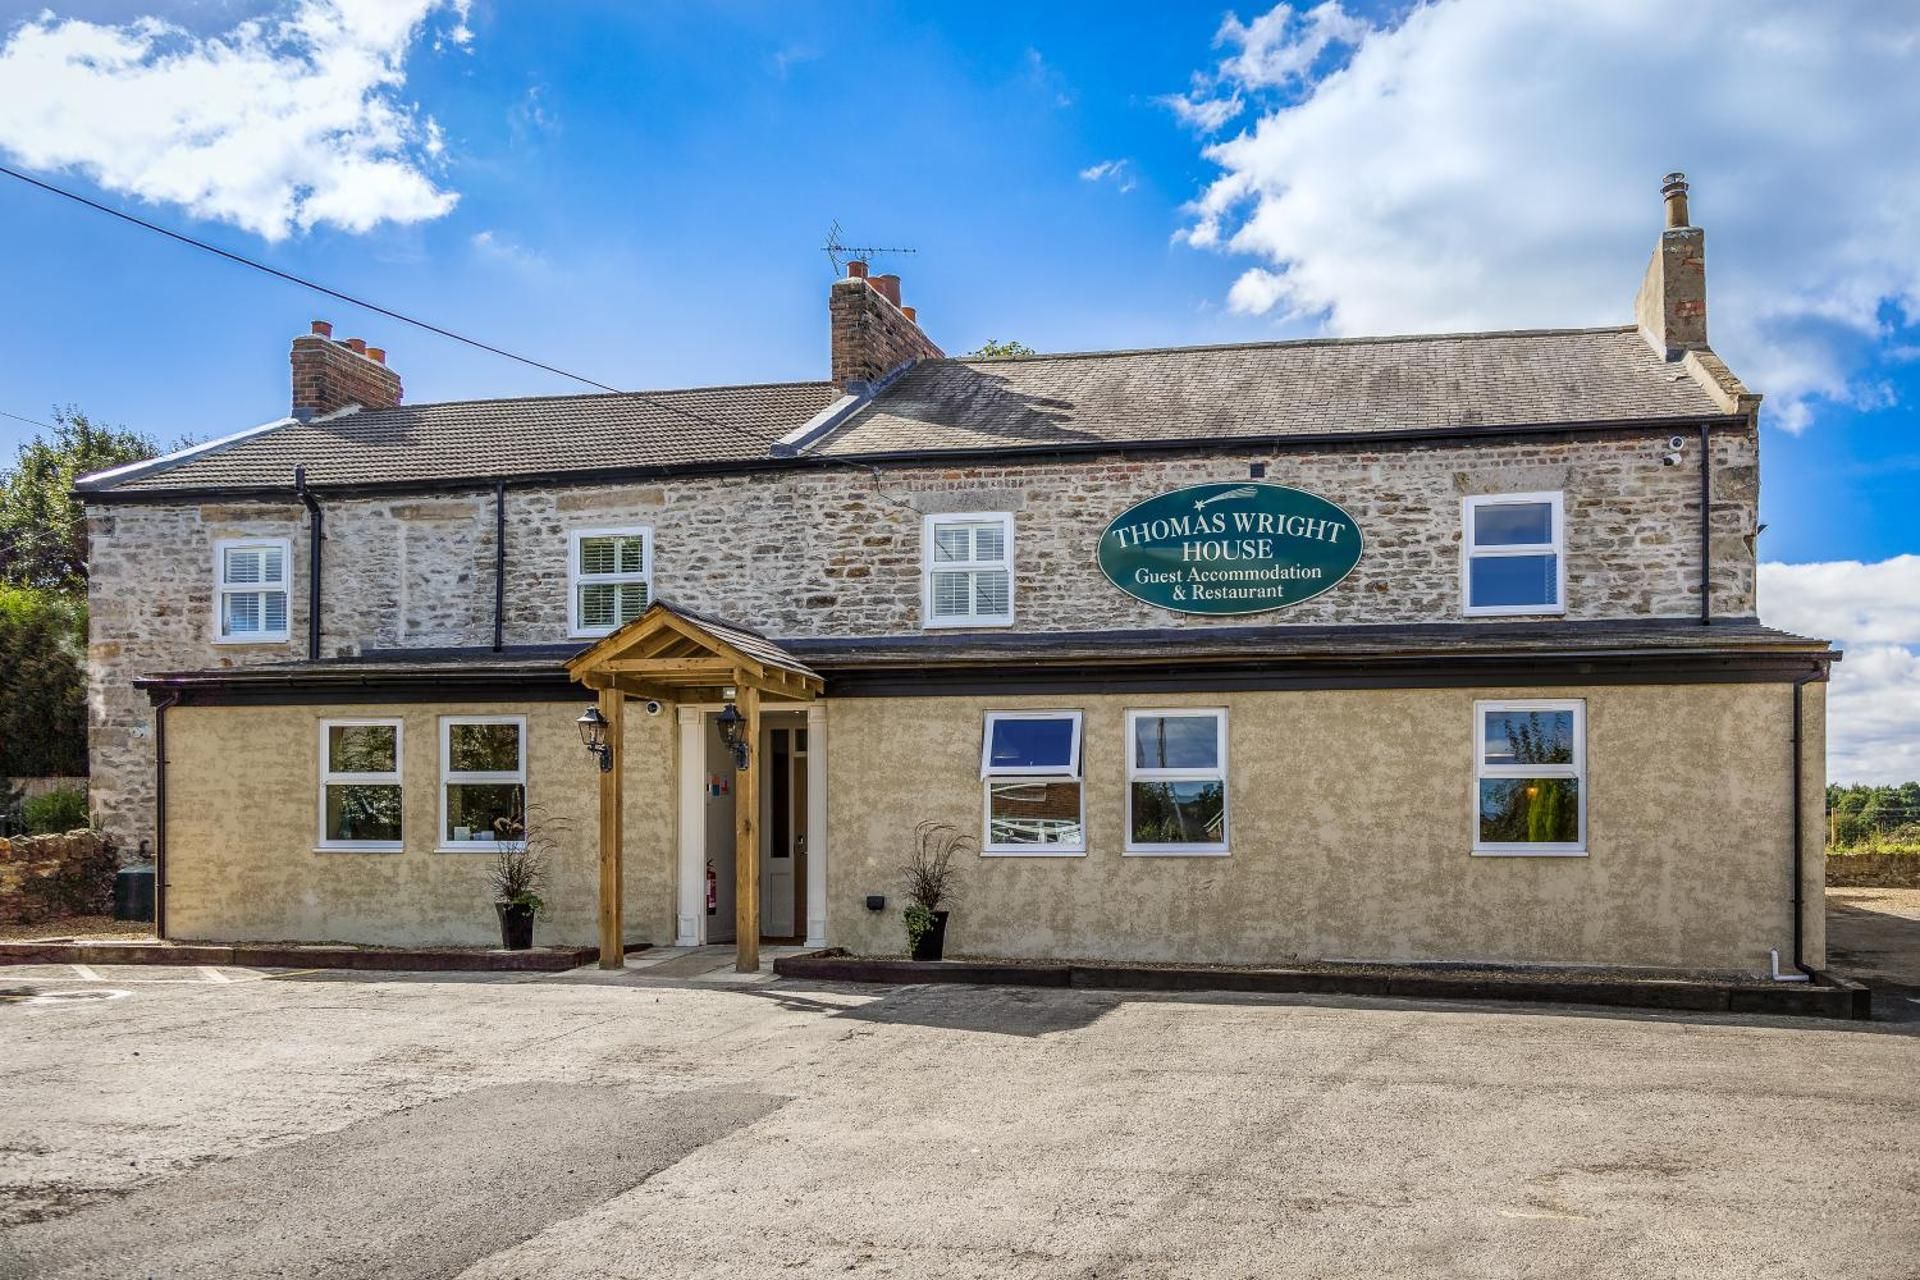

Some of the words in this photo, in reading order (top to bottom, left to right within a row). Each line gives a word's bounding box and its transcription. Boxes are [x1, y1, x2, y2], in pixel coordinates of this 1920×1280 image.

[1112, 512, 1225, 549] THOMAS
[1233, 512, 1346, 544] WRIGHT
[1182, 538, 1274, 562] HOUSE
[1135, 567, 1183, 585] Guest
[1187, 563, 1322, 583] Accommodation
[1172, 585, 1186, 601] &
[1192, 584, 1284, 600] Restaurant
